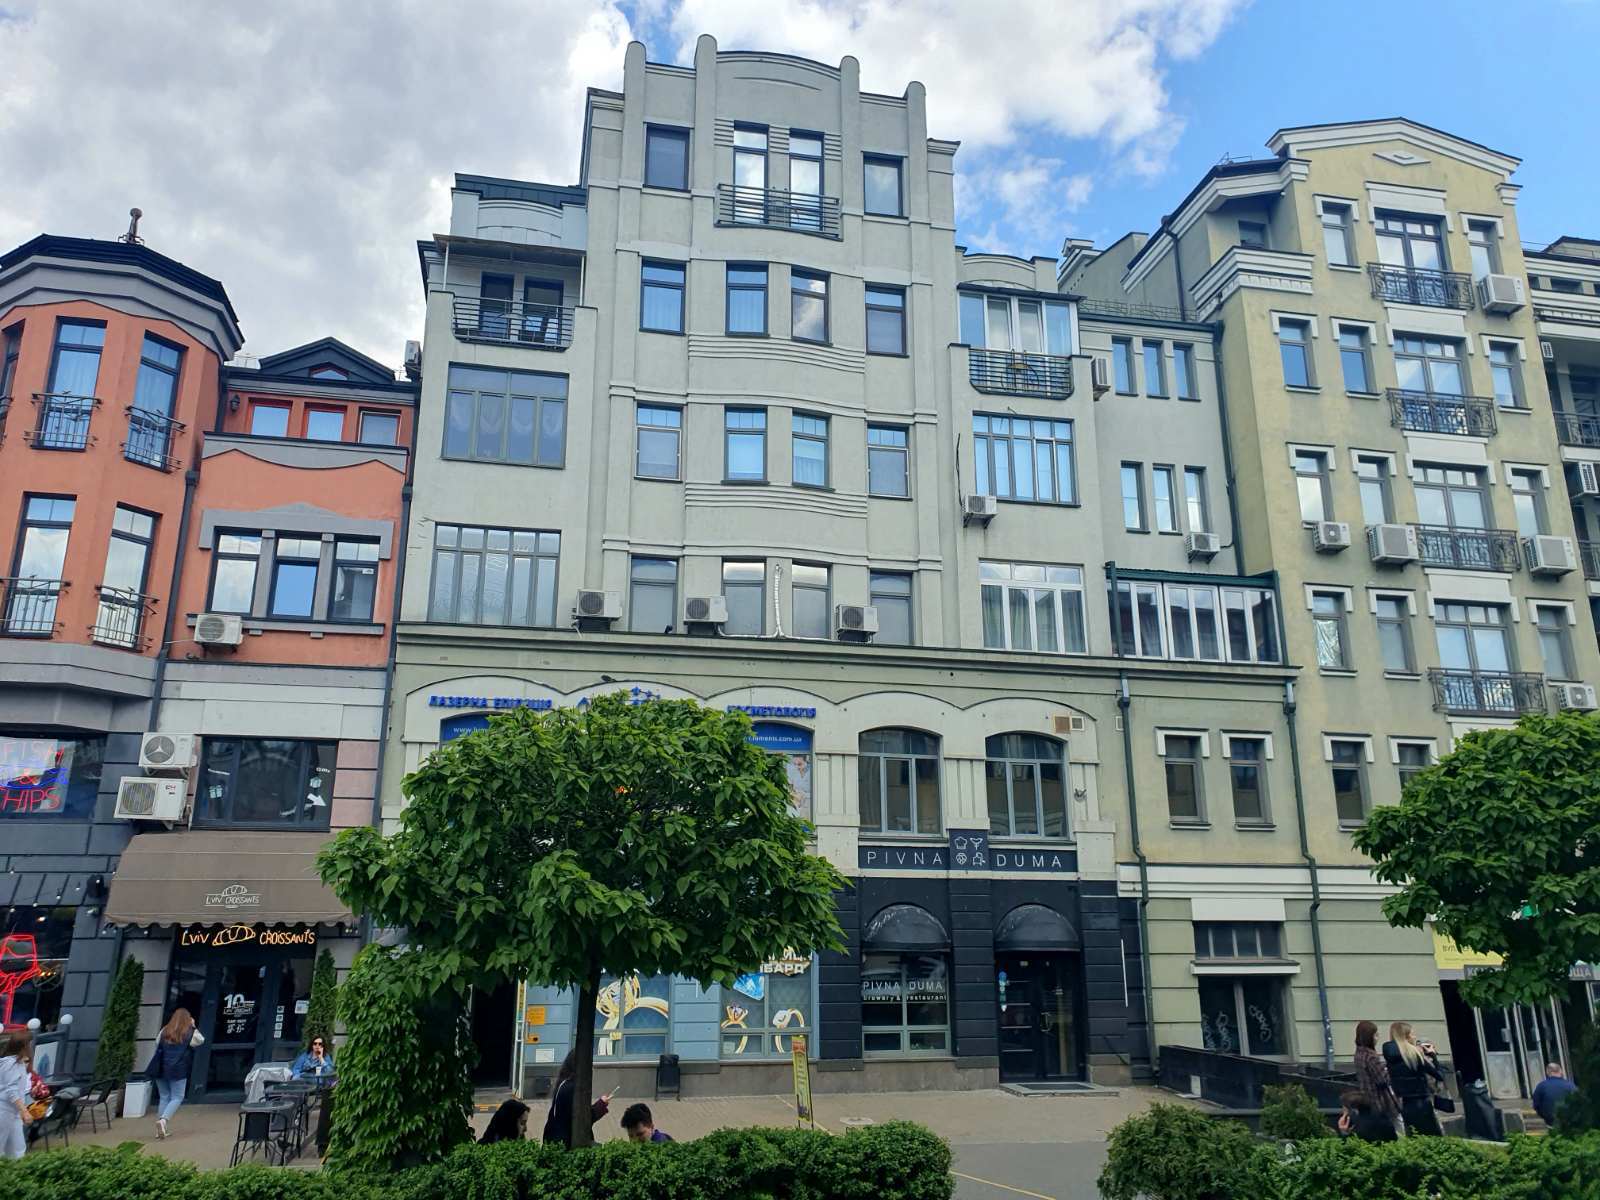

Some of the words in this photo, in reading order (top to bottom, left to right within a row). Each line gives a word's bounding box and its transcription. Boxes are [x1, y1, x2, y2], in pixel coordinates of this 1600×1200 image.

[429, 696, 487, 707] ЛАЗЕРНА
[493, 698, 553, 709] ЕПІЛЦІЯ
[867, 851, 942, 865] PIVNA
[996, 855, 1062, 868] DUMA
[225, 895, 260, 905] CROISSANTS
[260, 929, 316, 945] CROISSANTS
[863, 981, 901, 990] PIVNA
[909, 981, 943, 990] DUMA
